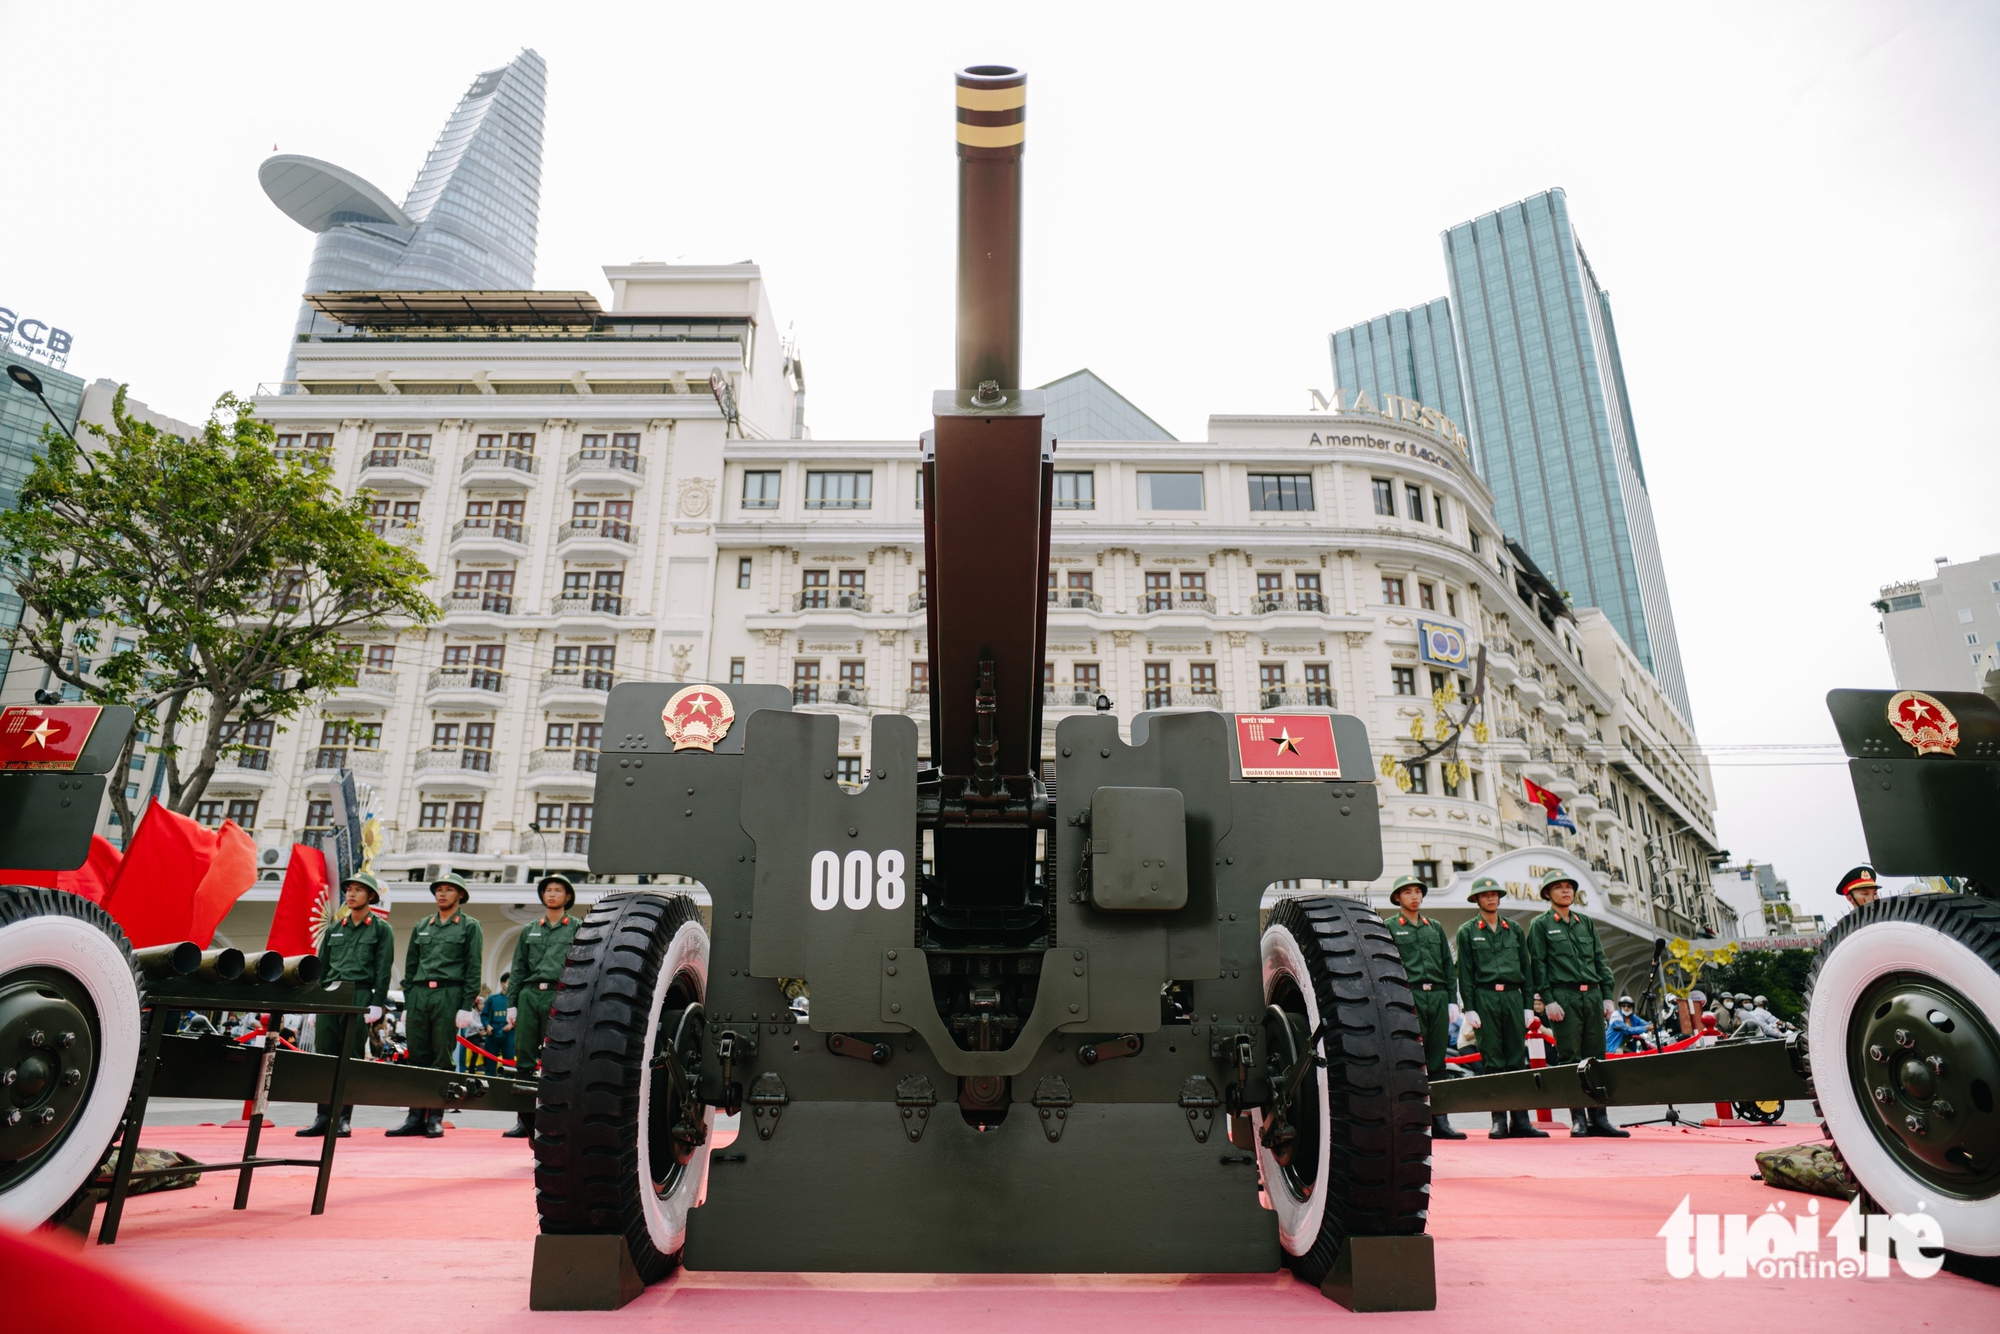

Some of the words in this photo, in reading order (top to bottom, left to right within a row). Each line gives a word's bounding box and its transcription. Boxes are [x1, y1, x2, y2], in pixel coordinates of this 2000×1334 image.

[0, 306, 74, 353] SCB
[1307, 388, 1470, 459] MAJESTIC
[1309, 432, 1323, 446] A
[1326, 433, 1390, 451] member
[1394, 440, 1406, 454] of
[1422, 622, 1465, 664] 100
[810, 849, 906, 911] 008
